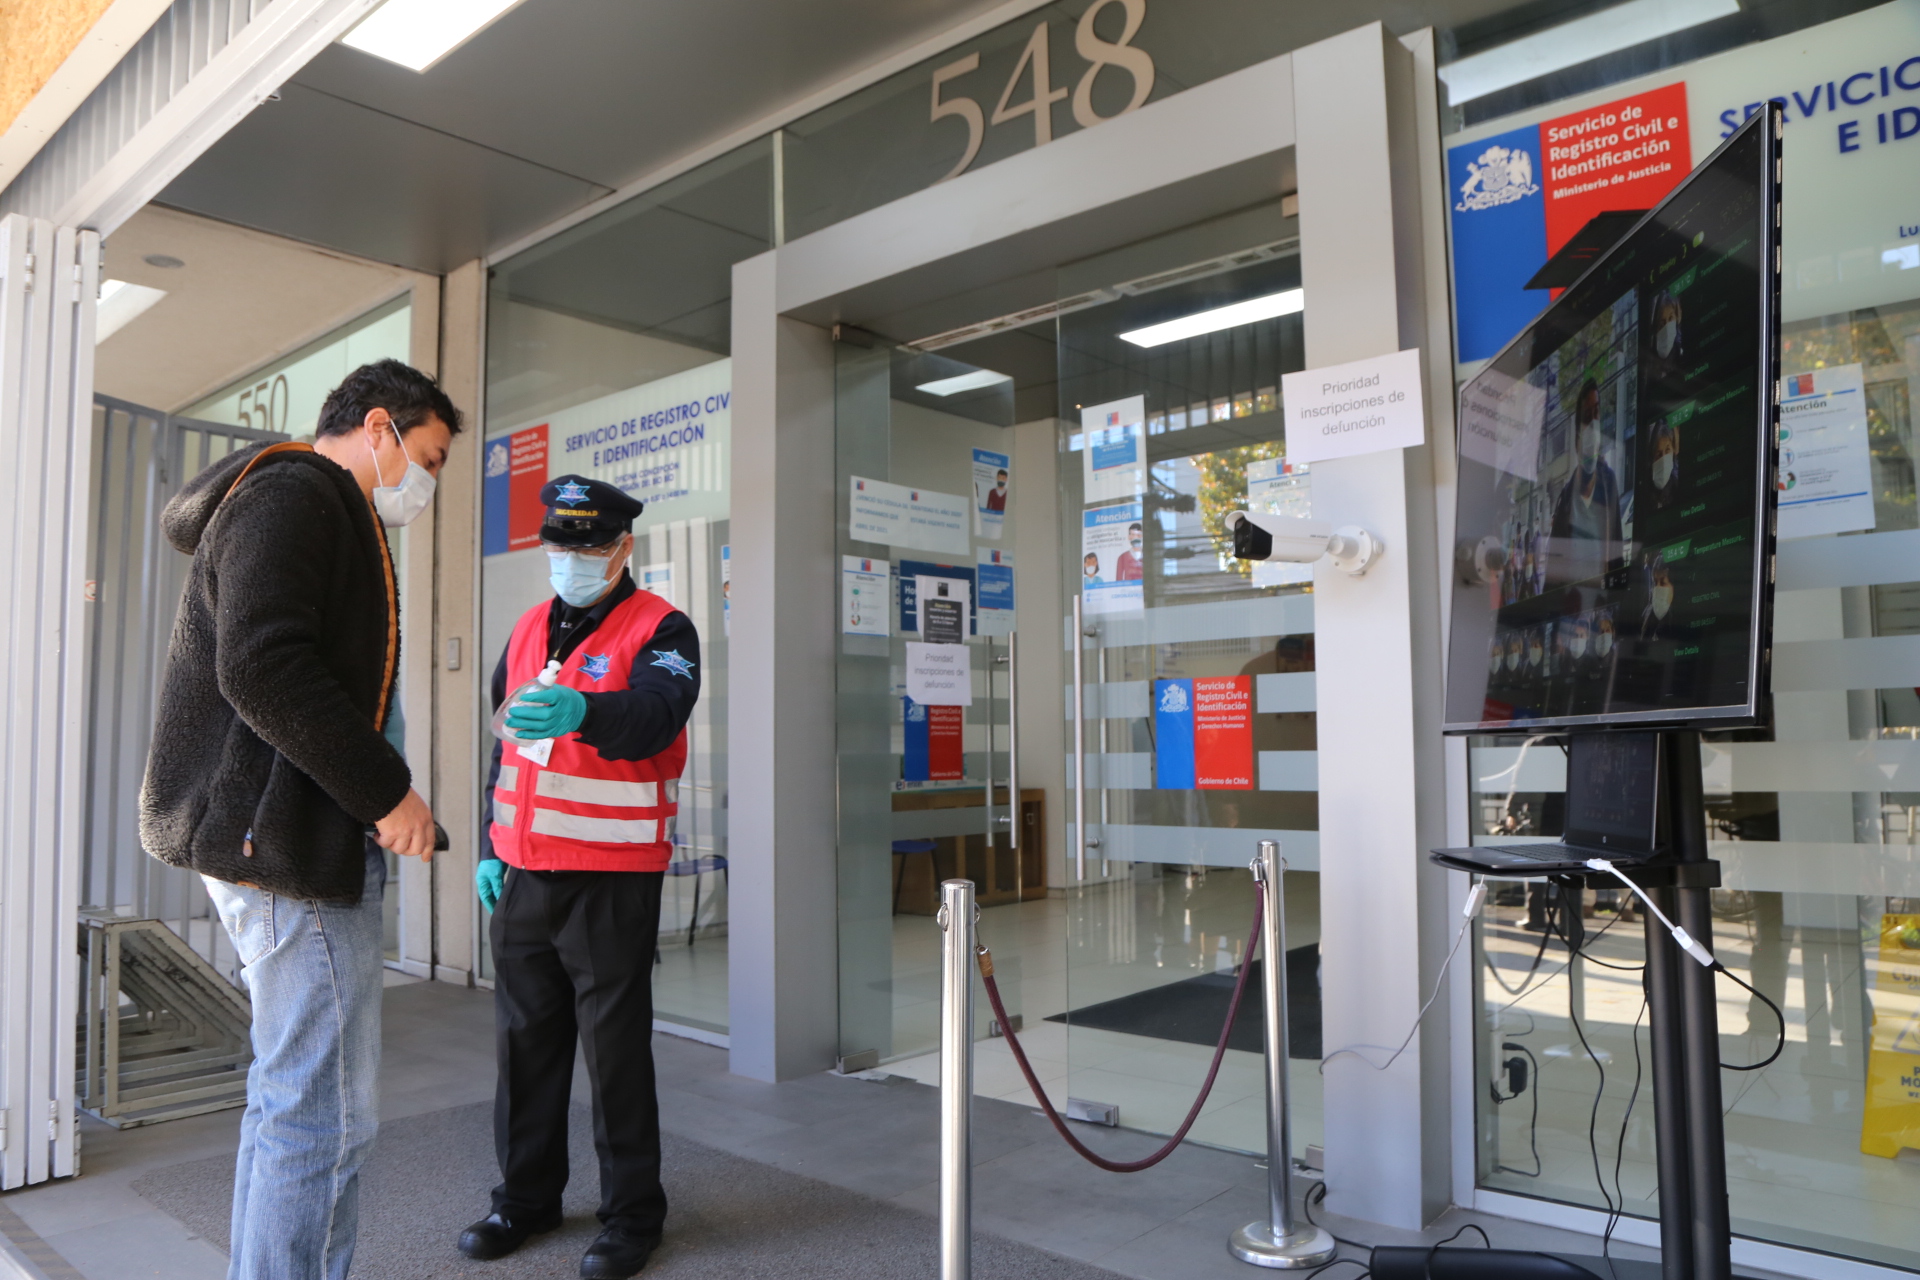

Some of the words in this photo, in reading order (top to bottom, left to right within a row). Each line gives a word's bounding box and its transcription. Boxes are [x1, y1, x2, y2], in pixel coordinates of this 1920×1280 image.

[929, 0, 1155, 187] 548
[1548, 113, 1617, 143] Servicio
[1620, 105, 1642, 122] de
[1550, 133, 1619, 162] Registro
[1623, 117, 1663, 141] Civil
[1667, 116, 1678, 129] e
[1838, 119, 1860, 154] E
[1551, 139, 1670, 181] Identificación
[1553, 178, 1609, 200] Ministerio
[1611, 174, 1625, 185] de
[1627, 161, 1672, 181] Justicia
[1322, 373, 1380, 396] Prioridad
[238, 374, 288, 432] 550
[1300, 394, 1385, 420] inscripciones
[1388, 390, 1405, 403] de
[1698, 396, 1726, 415] Temperature
[1780, 399, 1827, 416] Atención
[566, 424, 618, 453] SERVICIO
[621, 418, 637, 437] DE
[640, 401, 701, 432] REGISTRO
[1322, 414, 1386, 436] defunción
[594, 451, 600, 467] E
[603, 422, 705, 465] IDENTIFICACIÓN
[1269, 478, 1301, 489] Atencin
[555, 508, 599, 517] SEGURIDAD
[1095, 511, 1131, 524] Atención
[1680, 509, 1691, 518] View
[1690, 502, 1706, 514] Details
[1694, 543, 1721, 555] Temperature
[925, 653, 954, 663] Prioridad
[1674, 648, 1684, 657] View
[1684, 645, 1700, 655] Details
[914, 666, 955, 677] inscripciones
[956, 668, 964, 677] de
[924, 679, 955, 689] defunción
[1196, 682, 1225, 691] Servicio
[1226, 681, 1236, 690] de
[1196, 693, 1225, 703] Registro
[1226, 691, 1243, 700] Civil
[1197, 701, 1247, 712] Identificación
[1198, 777, 1224, 785] Gobierno
[1225, 777, 1232, 785] de
[1233, 777, 1249, 785] Chile
